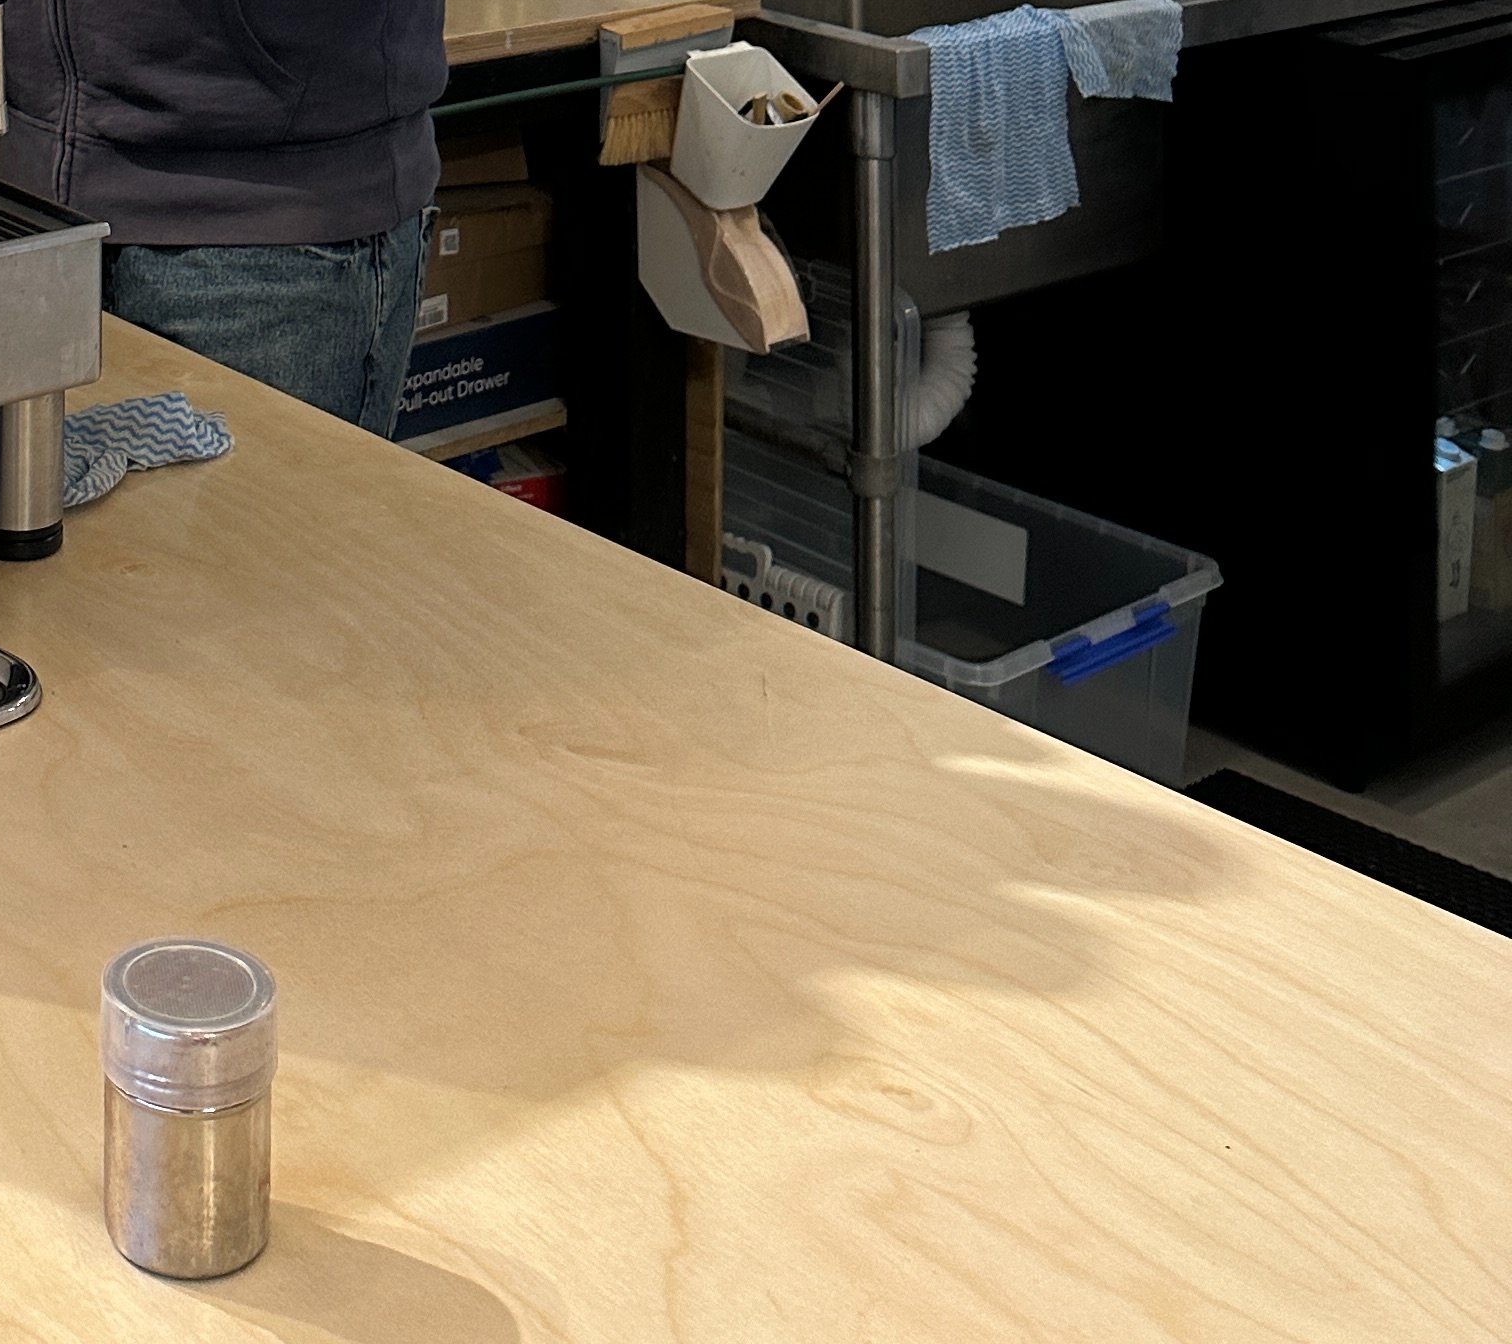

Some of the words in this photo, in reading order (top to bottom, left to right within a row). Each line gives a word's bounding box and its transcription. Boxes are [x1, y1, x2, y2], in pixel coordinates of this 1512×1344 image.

[396, 385, 454, 412] Pull-out
[457, 370, 511, 396] Drawer
[400, 356, 485, 391] xpandable
